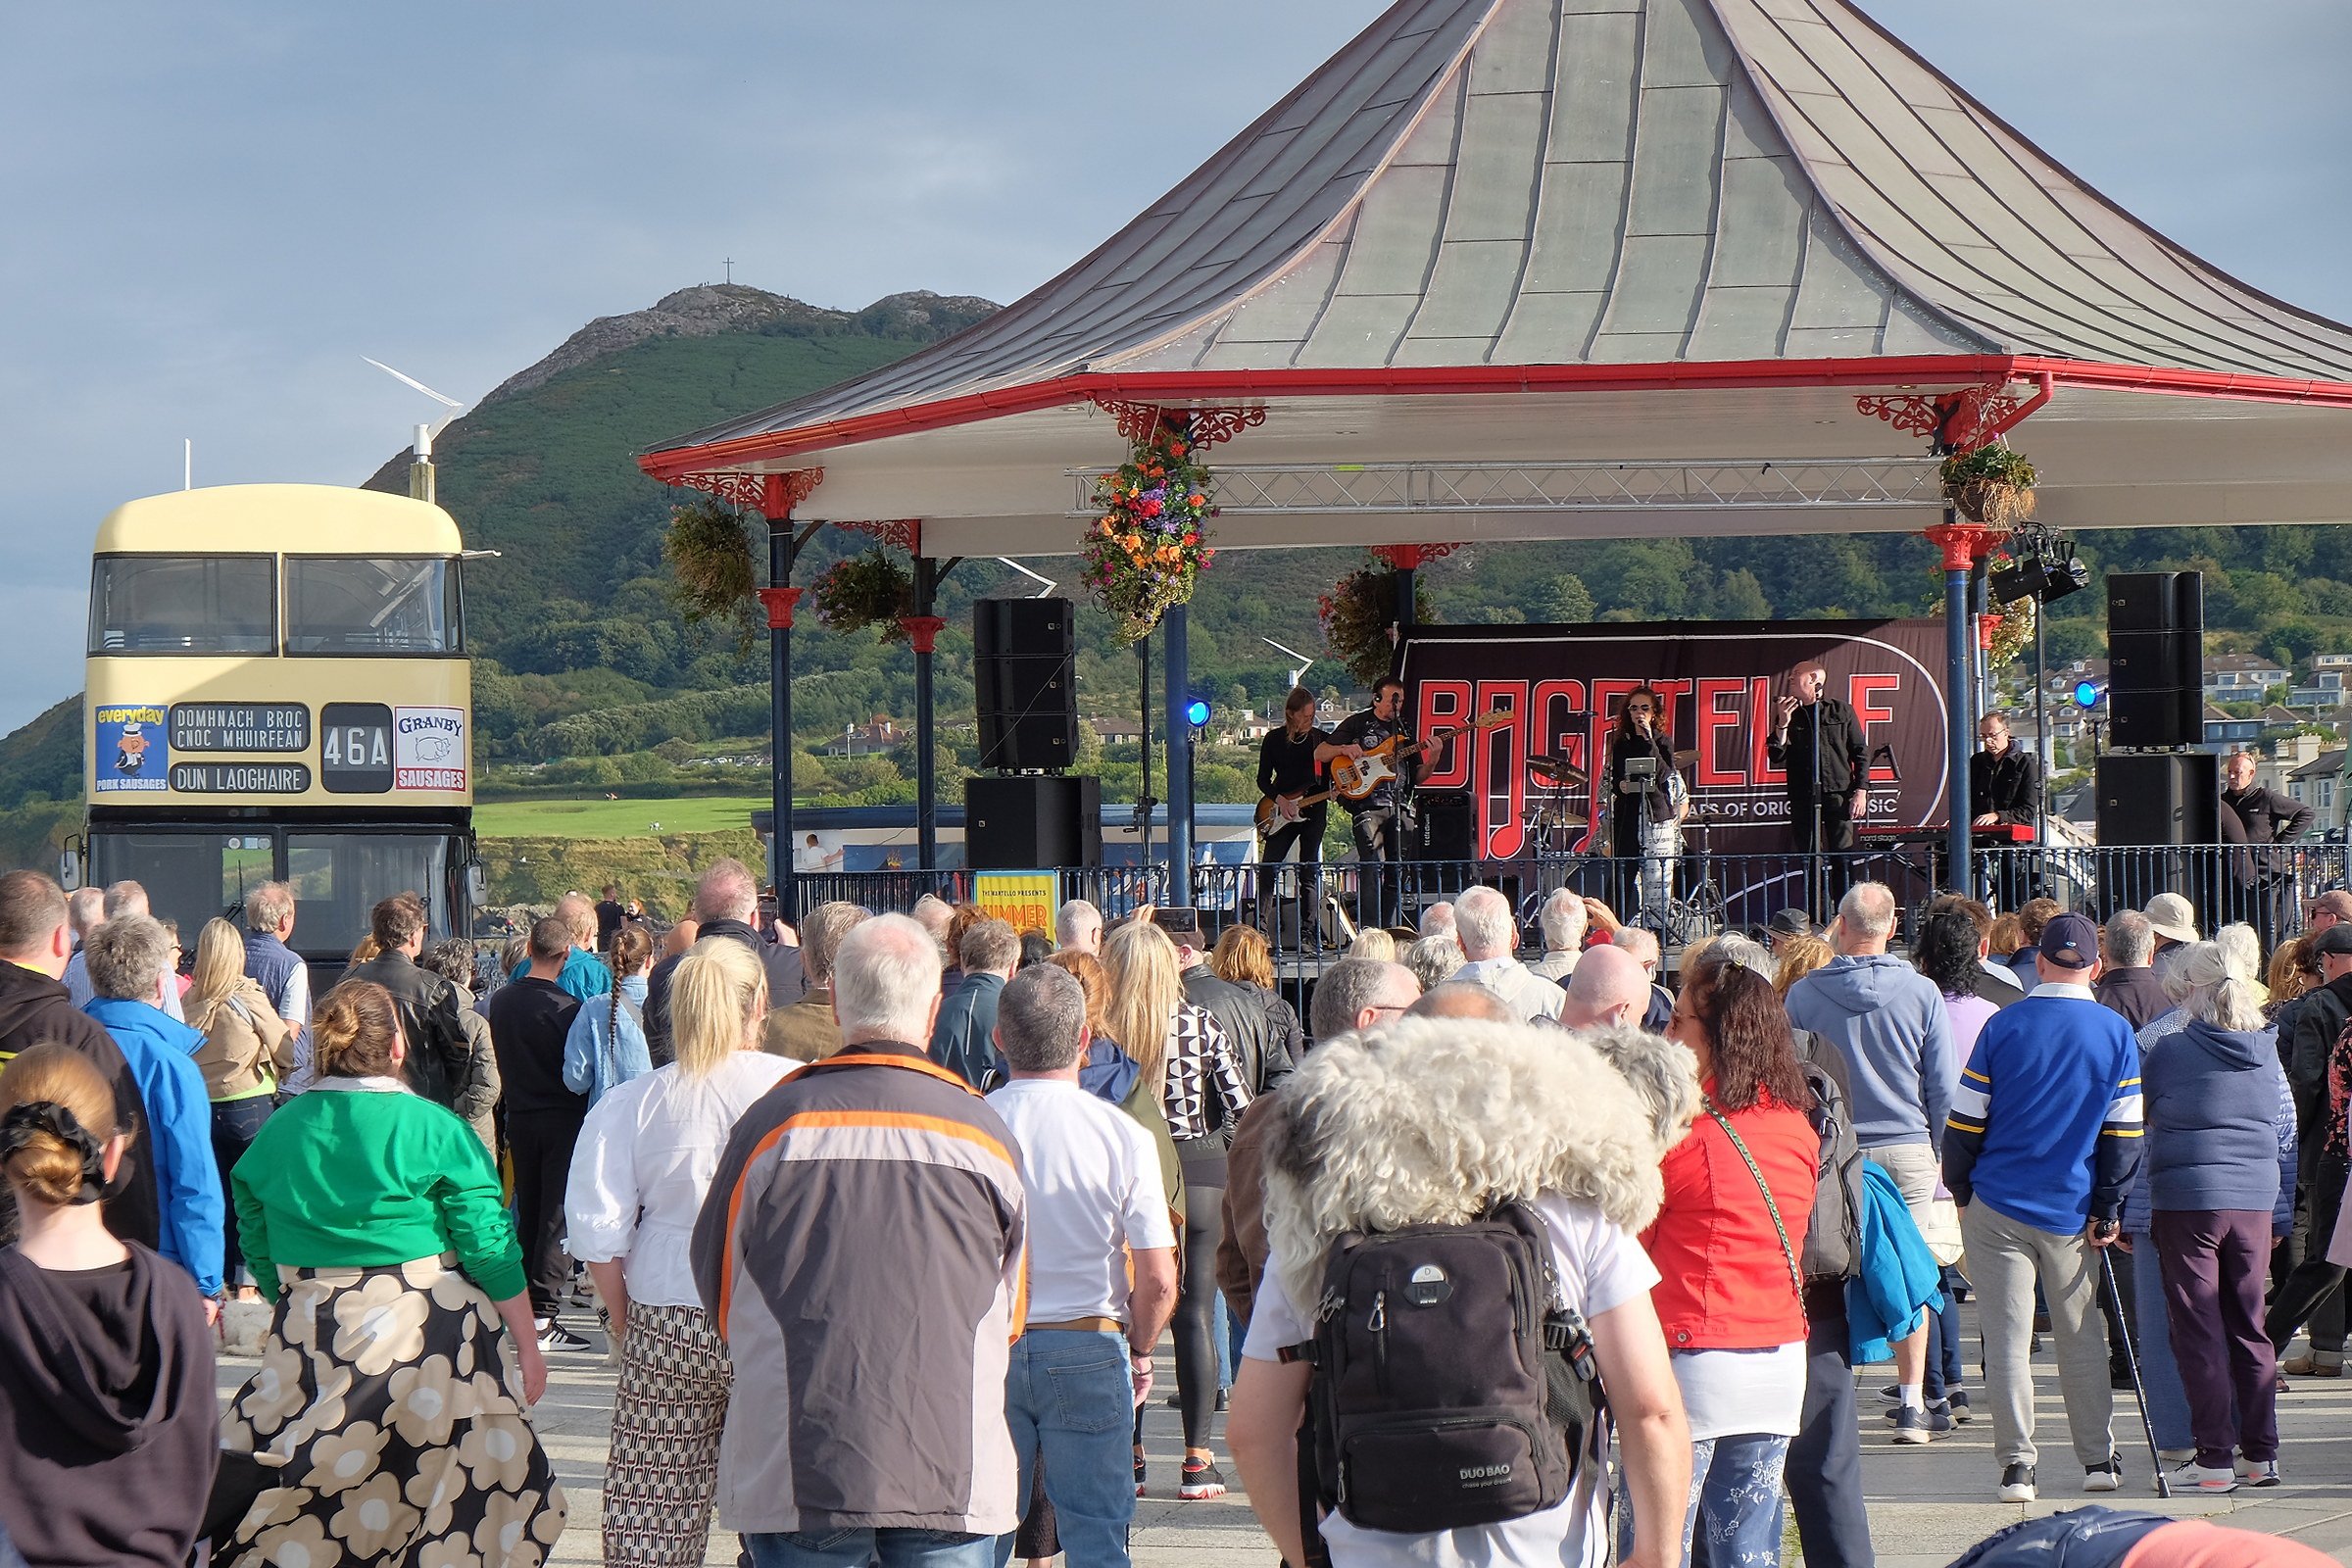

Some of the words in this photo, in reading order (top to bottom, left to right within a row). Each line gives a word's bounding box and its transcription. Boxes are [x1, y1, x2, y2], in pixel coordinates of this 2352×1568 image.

[97, 706, 165, 725] everyday
[176, 710, 254, 728] DOMHNACH
[267, 710, 303, 728] BROC
[398, 716, 463, 737] GRANBY
[176, 729, 212, 748] CNOC
[223, 730, 303, 748] MHUIRFEAN
[323, 727, 389, 765] 46A
[1414, 674, 1900, 860] BAGATELE
[96, 779, 119, 791] PORK
[119, 778, 167, 790] SAUSAGES
[176, 768, 207, 790] DUN
[217, 768, 302, 791] LAOGHAIRE
[398, 770, 465, 789] SAUSAGES
[1724, 802, 1748, 817] OF
[1459, 1468, 1485, 1480] DUO
[1486, 1464, 1510, 1477] BAO
